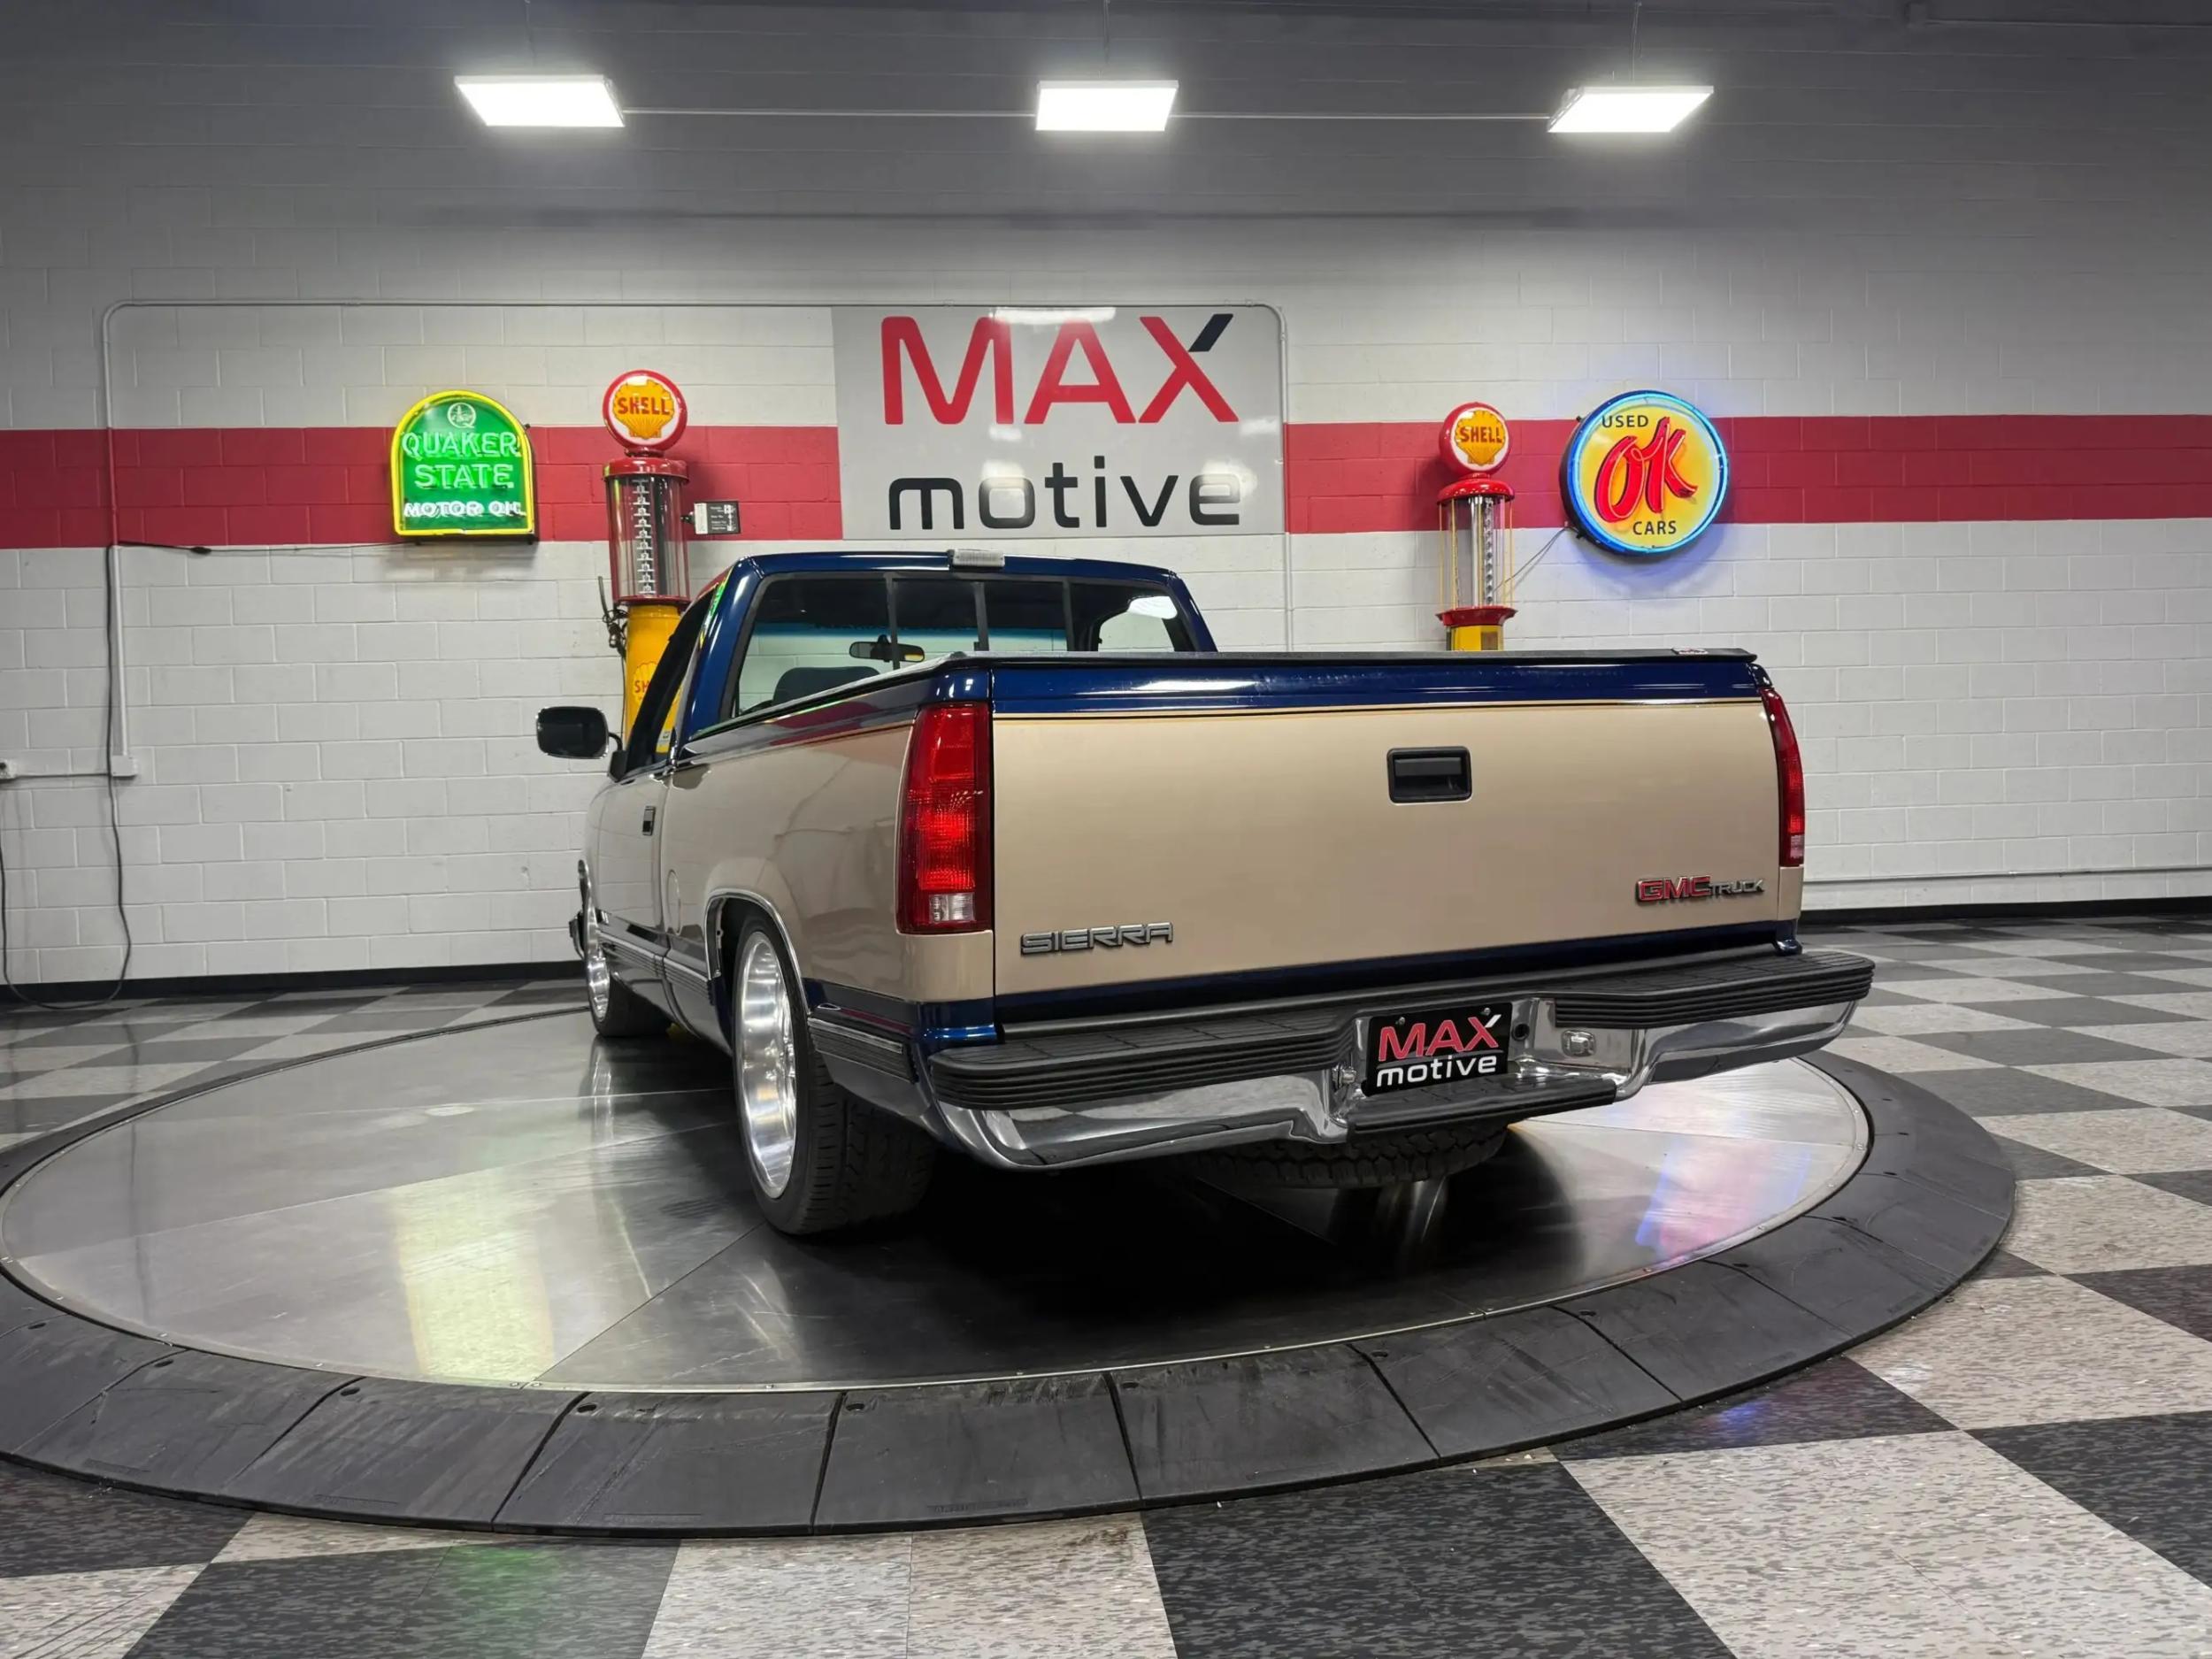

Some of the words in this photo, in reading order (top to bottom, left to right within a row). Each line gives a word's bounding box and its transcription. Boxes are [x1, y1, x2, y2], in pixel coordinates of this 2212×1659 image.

[881, 313, 1239, 425] MAX
[617, 396, 671, 416] SHELL
[1459, 426, 1502, 443] SHELL
[1601, 415, 1648, 428] USED
[402, 431, 522, 461] QUAKER
[414, 464, 515, 489] STATE
[1594, 417, 1698, 523] OK
[888, 456, 1241, 530] motive
[403, 501, 485, 518] MOTOR
[488, 500, 527, 518] OIL
[1632, 520, 1677, 534] CARS
[1636, 874, 1711, 902] GMC
[1709, 879, 1764, 896] TRUCK
[1021, 922, 1173, 955] SIERRA
[1378, 1014, 1502, 1063] MAX
[1376, 1055, 1497, 1087] motive
